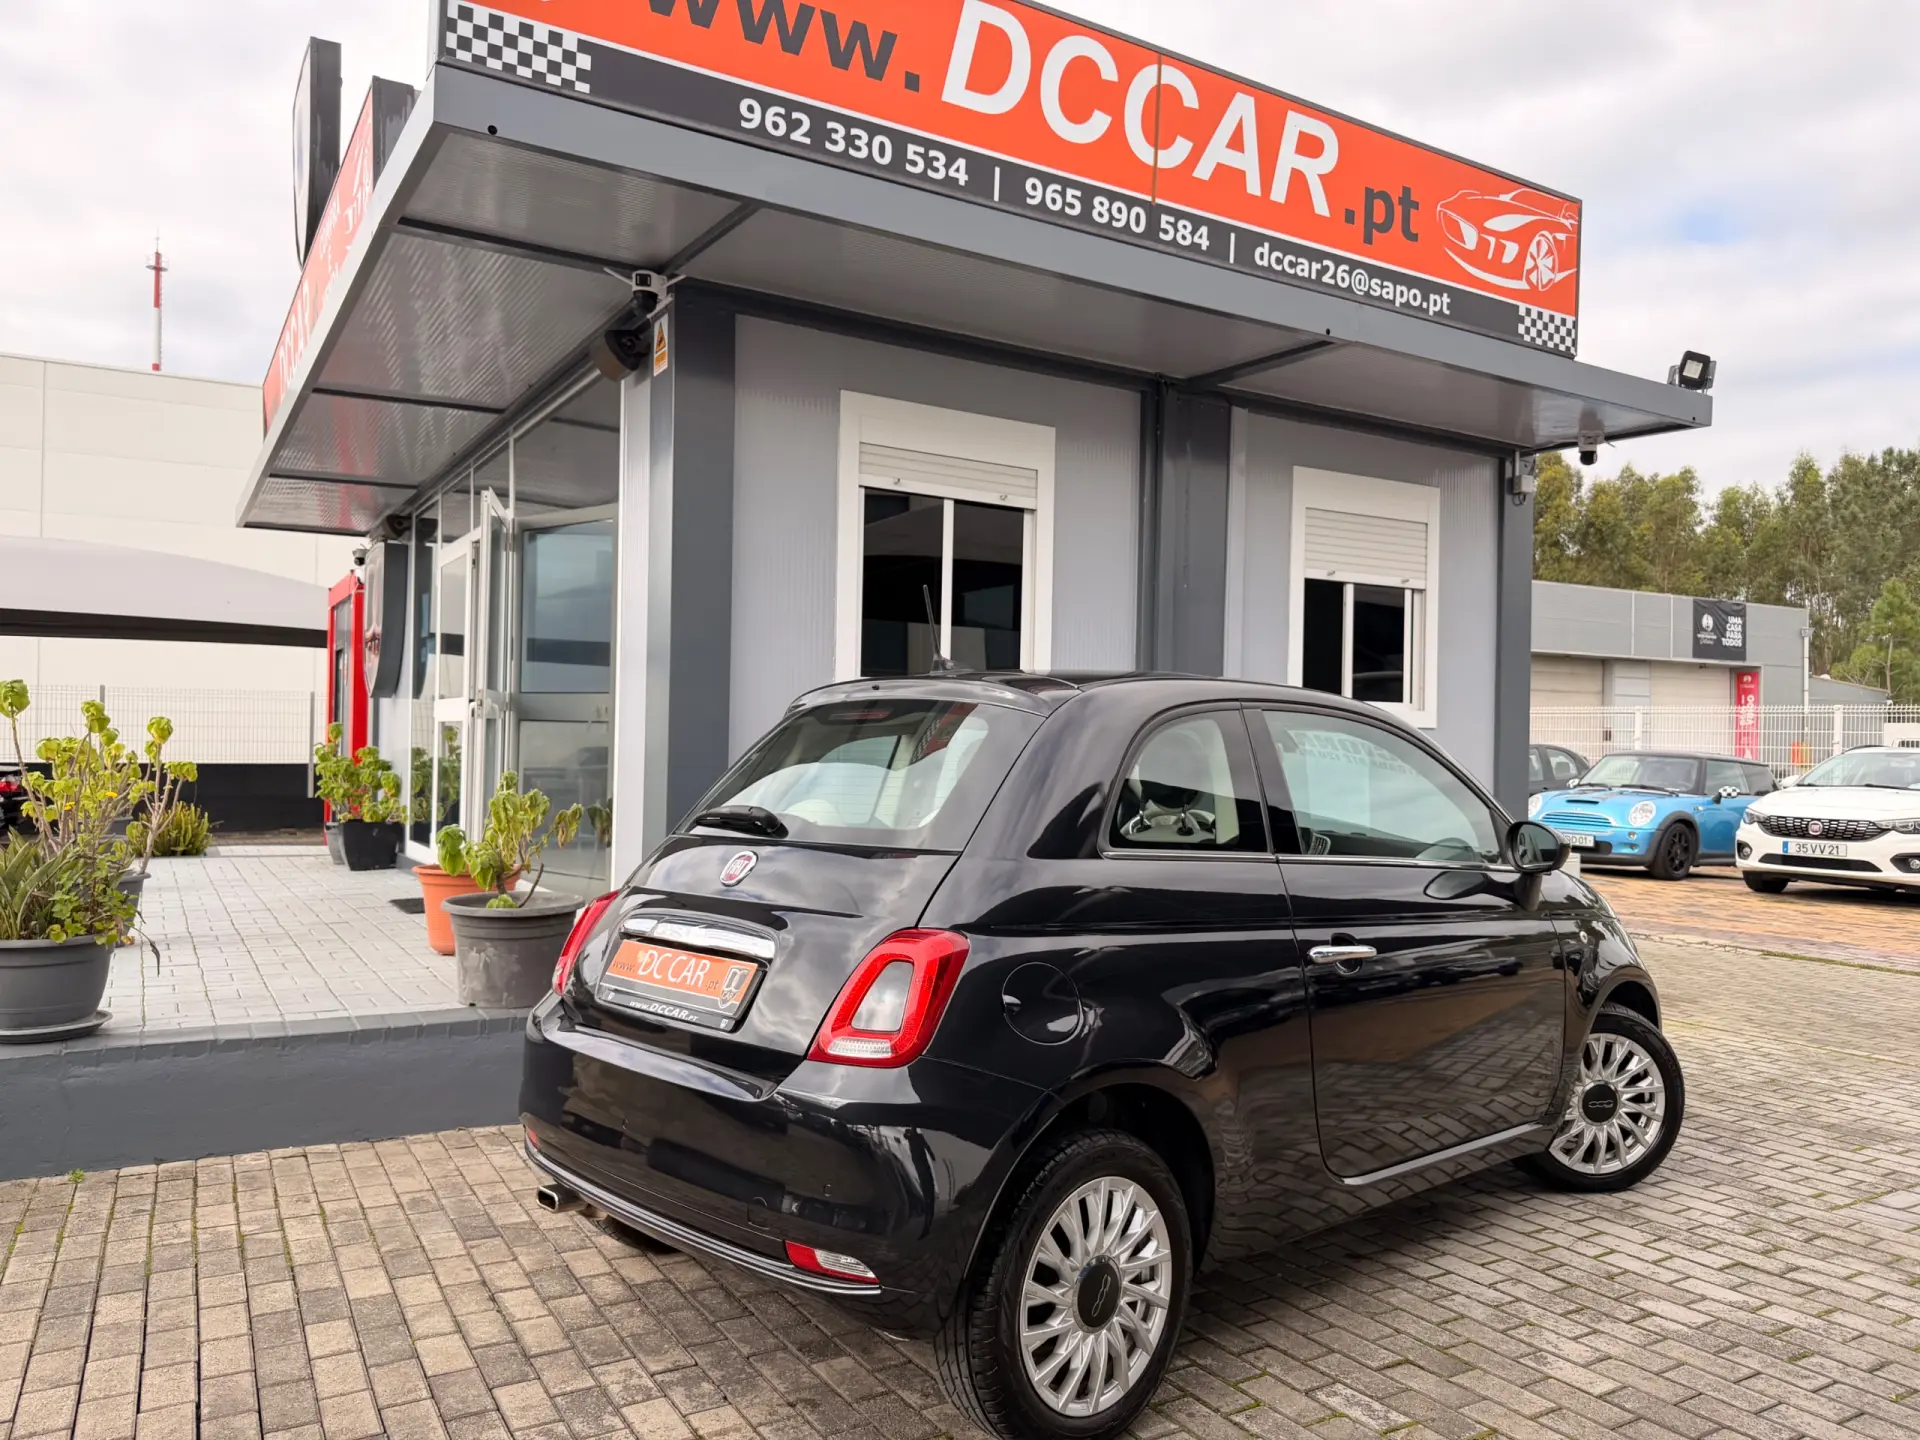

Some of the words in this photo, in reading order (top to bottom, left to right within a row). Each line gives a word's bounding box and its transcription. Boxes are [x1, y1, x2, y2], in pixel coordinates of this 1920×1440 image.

[739, 98, 811, 144] 962
[824, 121, 893, 165] 330
[905, 143, 969, 186] 534
[1025, 177, 1082, 216] 965
[1092, 196, 1146, 233] 890
[1159, 214, 1209, 251] 584
[1254, 242, 1451, 316] dccar26@sapo.pt
[1728, 616, 1742, 624] UMA
[1726, 623, 1742, 632] CASA
[1726, 631, 1742, 640] PARA
[1721, 638, 1742, 647] TODOS
